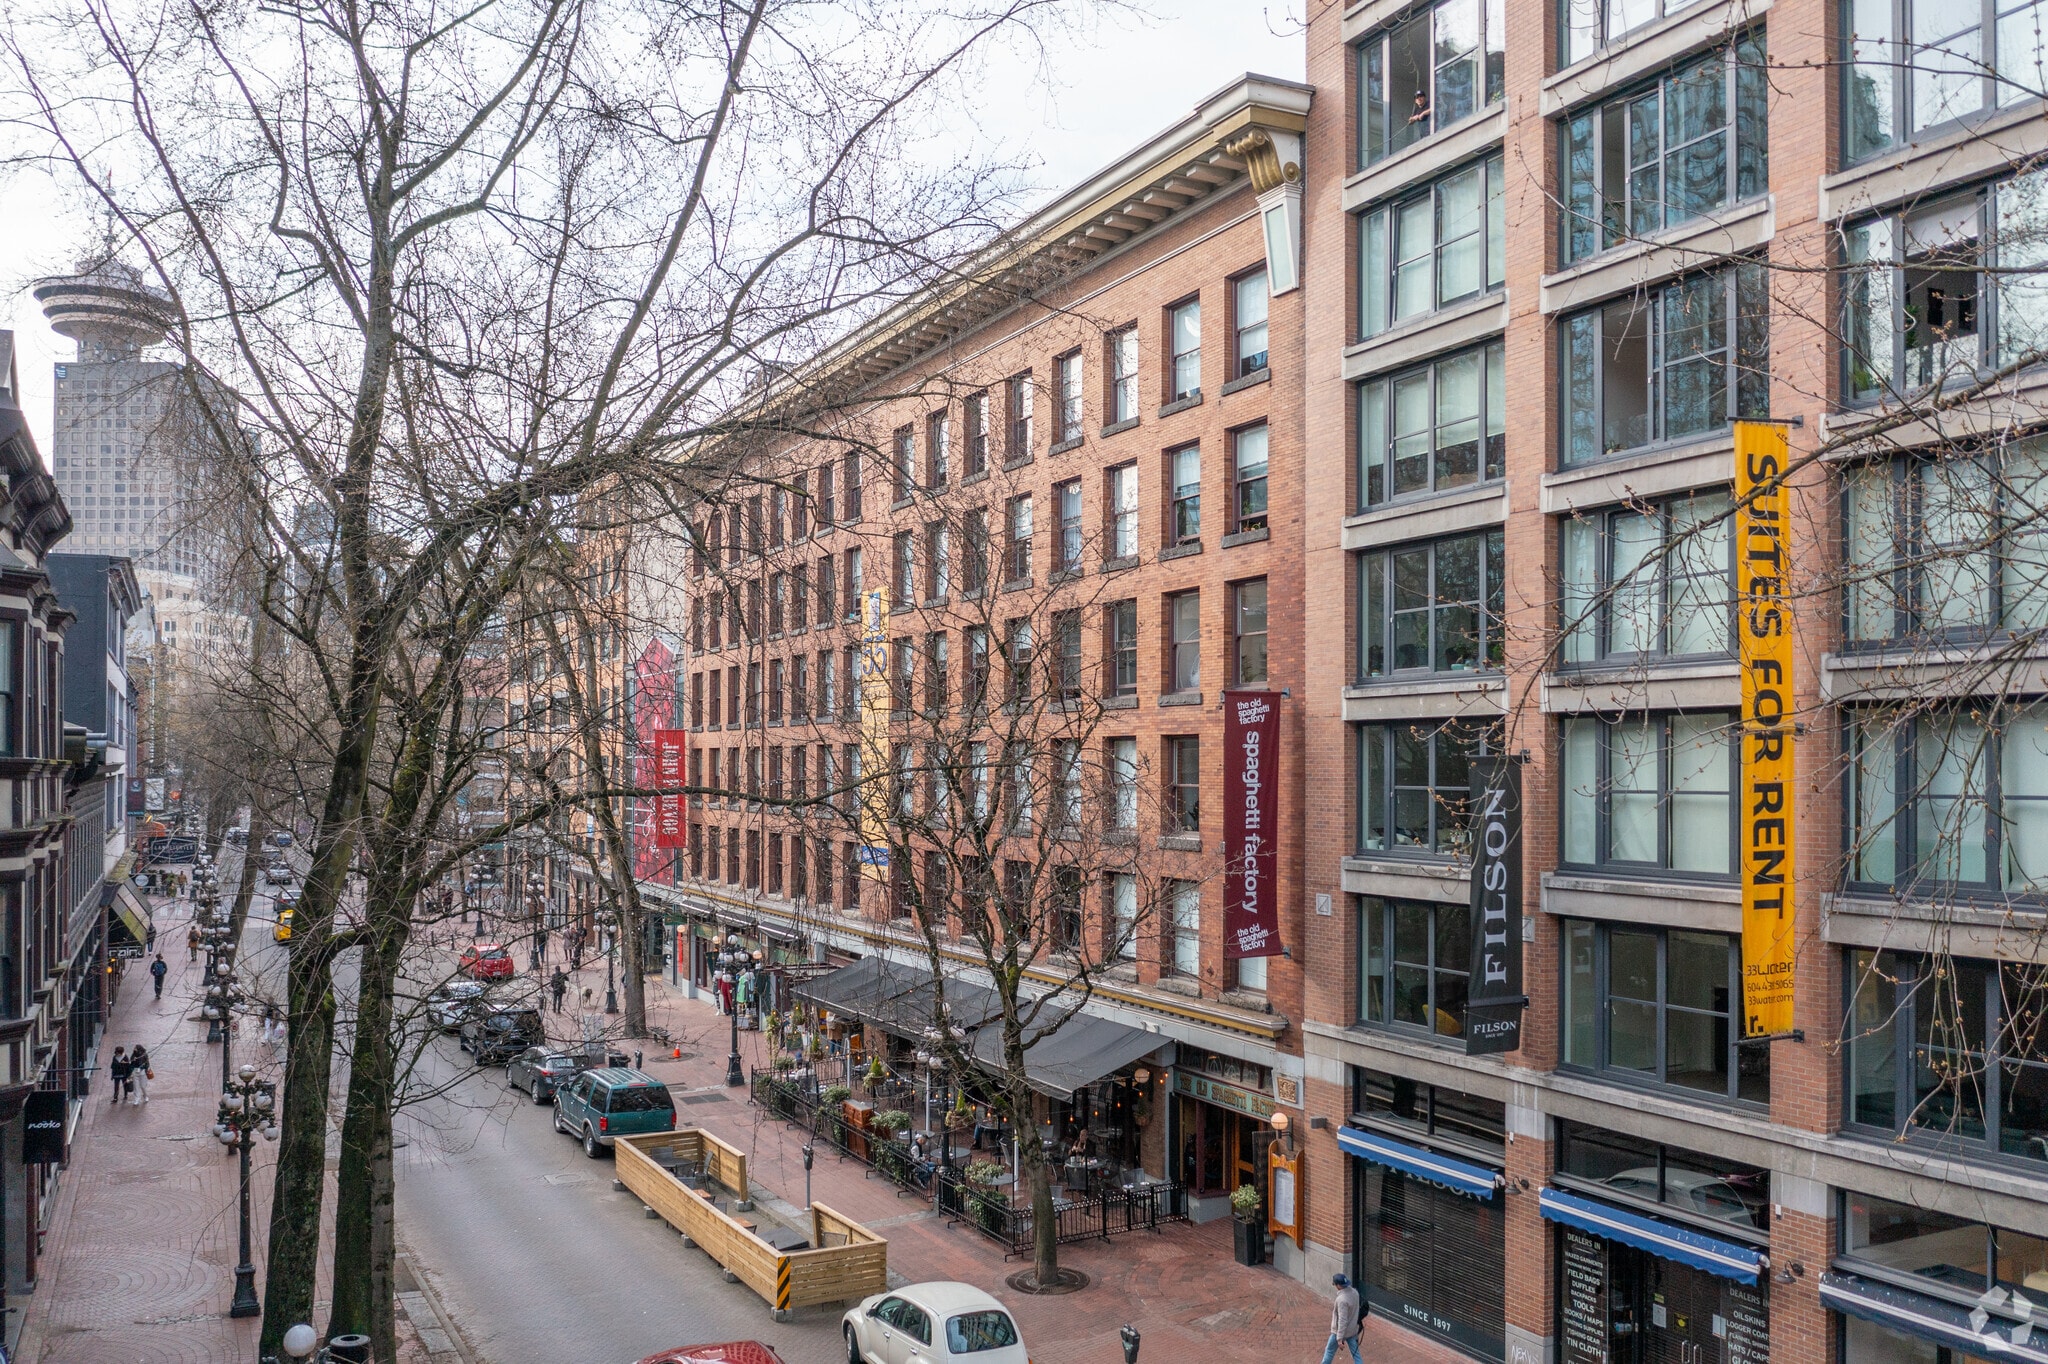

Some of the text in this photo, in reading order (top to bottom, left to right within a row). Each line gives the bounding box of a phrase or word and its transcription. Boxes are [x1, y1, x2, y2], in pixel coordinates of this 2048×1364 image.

[1747, 454, 1786, 919] SUITES FOR RENT
[1237, 698, 1261, 710] the old
[1238, 704, 1270, 717] spaghetti
[1239, 714, 1265, 725] factory
[662, 779, 679, 835] FUEVOG
[1242, 731, 1262, 914] spaghetti factory
[1484, 786, 1507, 986] FILSON
[1237, 923, 1260, 937] the old
[1239, 929, 1269, 944] spaghetti
[1241, 939, 1265, 952] factory
[1749, 995, 1794, 1006] 33wat.com
[1473, 1021, 1517, 1034] FILSON
[1567, 1233, 1601, 1250] DEALERS IN
[1568, 1269, 1600, 1286] FIELD BAGS
[1572, 1280, 1596, 1294] DUFFLES
[1571, 1289, 1597, 1303] BACKPACKS
[1730, 1288, 1761, 1305] DEALERS
[1573, 1299, 1594, 1313] TOOLS
[1404, 1304, 1450, 1331] SINCE 1897
[1564, 1307, 1582, 1319] BOOKS
[1587, 1315, 1603, 1327] MAPS
[1733, 1310, 1766, 1328] OILSKINS
[1727, 1320, 1770, 1341] LOGGER COAT
[1586, 1335, 1600, 1345] GEAR
[1729, 1332, 1751, 1344] FLANNEL
[1567, 1336, 1602, 1357] TIN CLOTH
[1728, 1341, 1746, 1355] HATS
